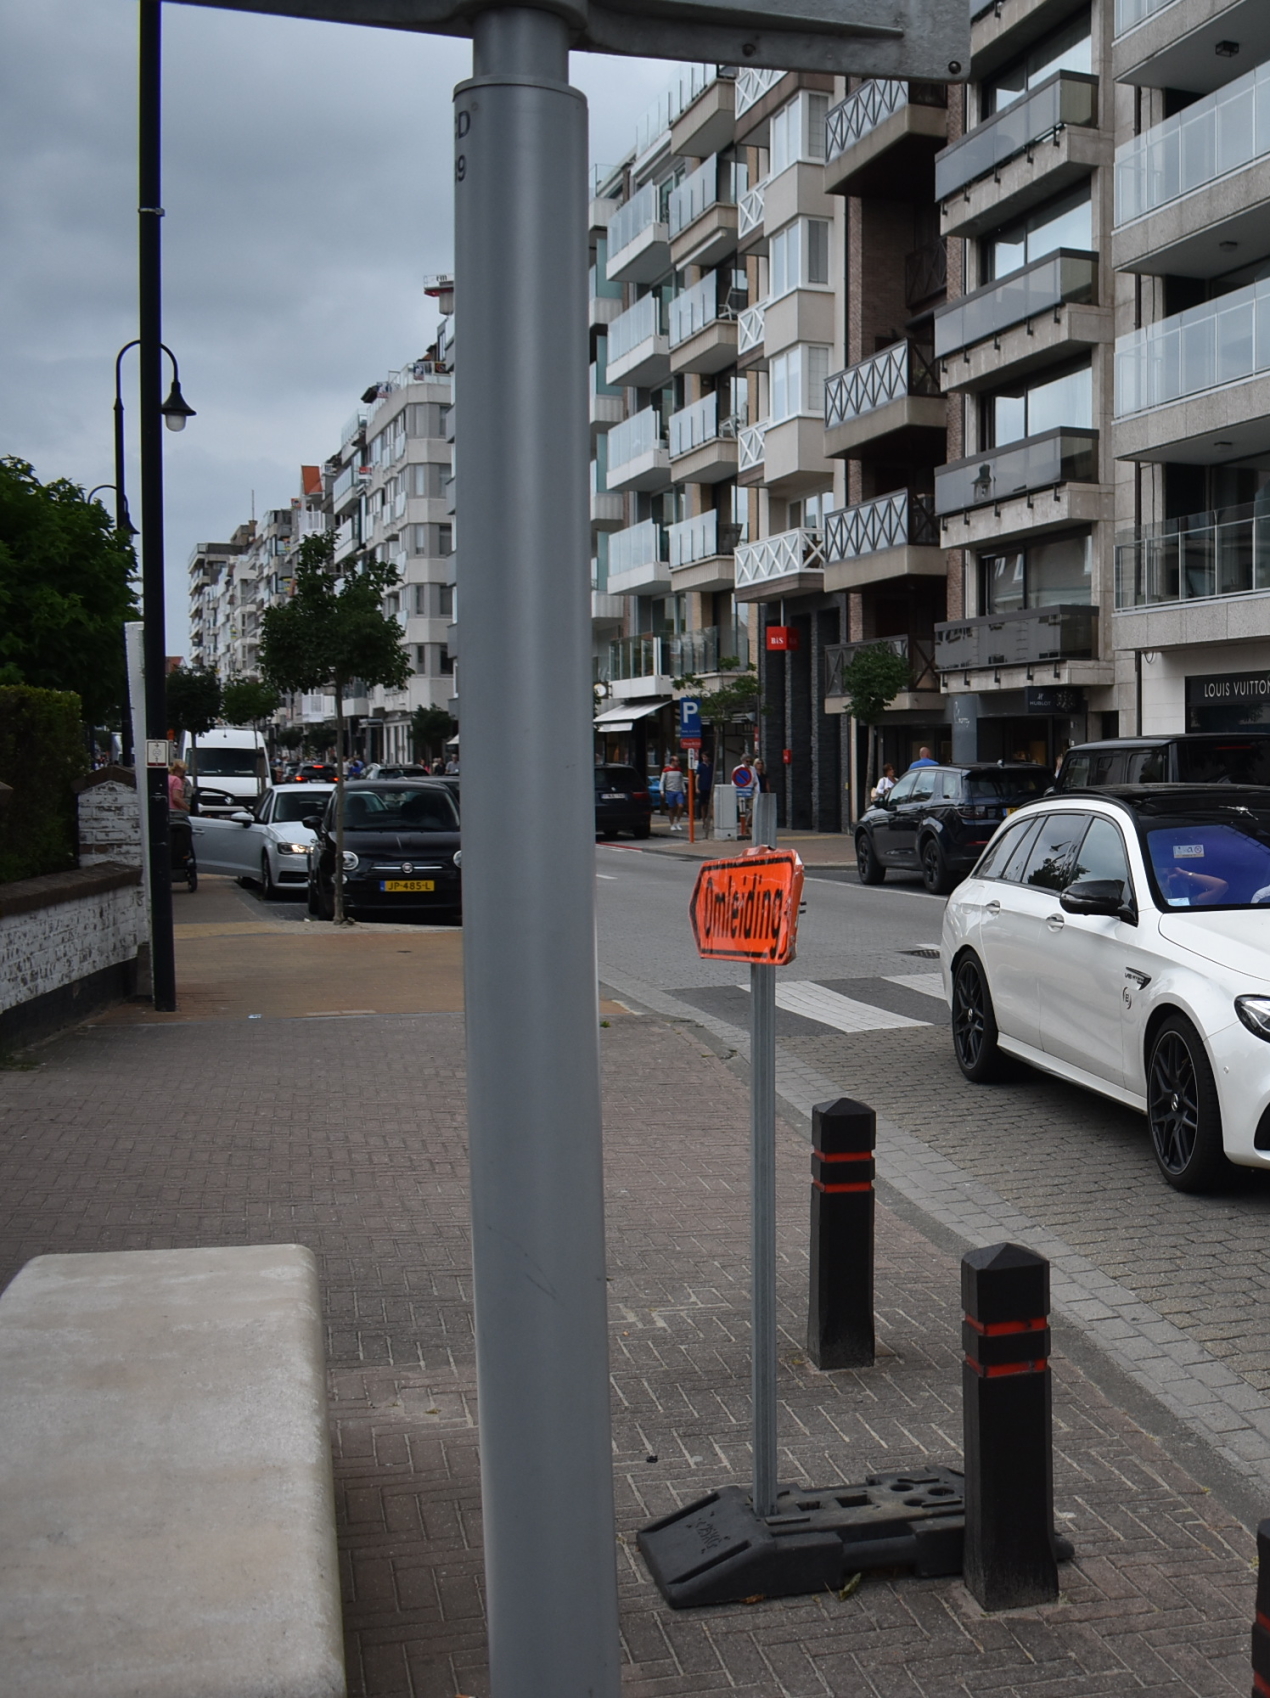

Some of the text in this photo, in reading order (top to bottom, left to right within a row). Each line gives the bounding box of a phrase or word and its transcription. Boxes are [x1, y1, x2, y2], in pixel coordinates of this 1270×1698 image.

[1204, 682, 1230, 698] LOUIS
[683, 702, 698, 723] P
[388, 882, 430, 890] JP-485-L
[704, 873, 784, 960] Omleiding
